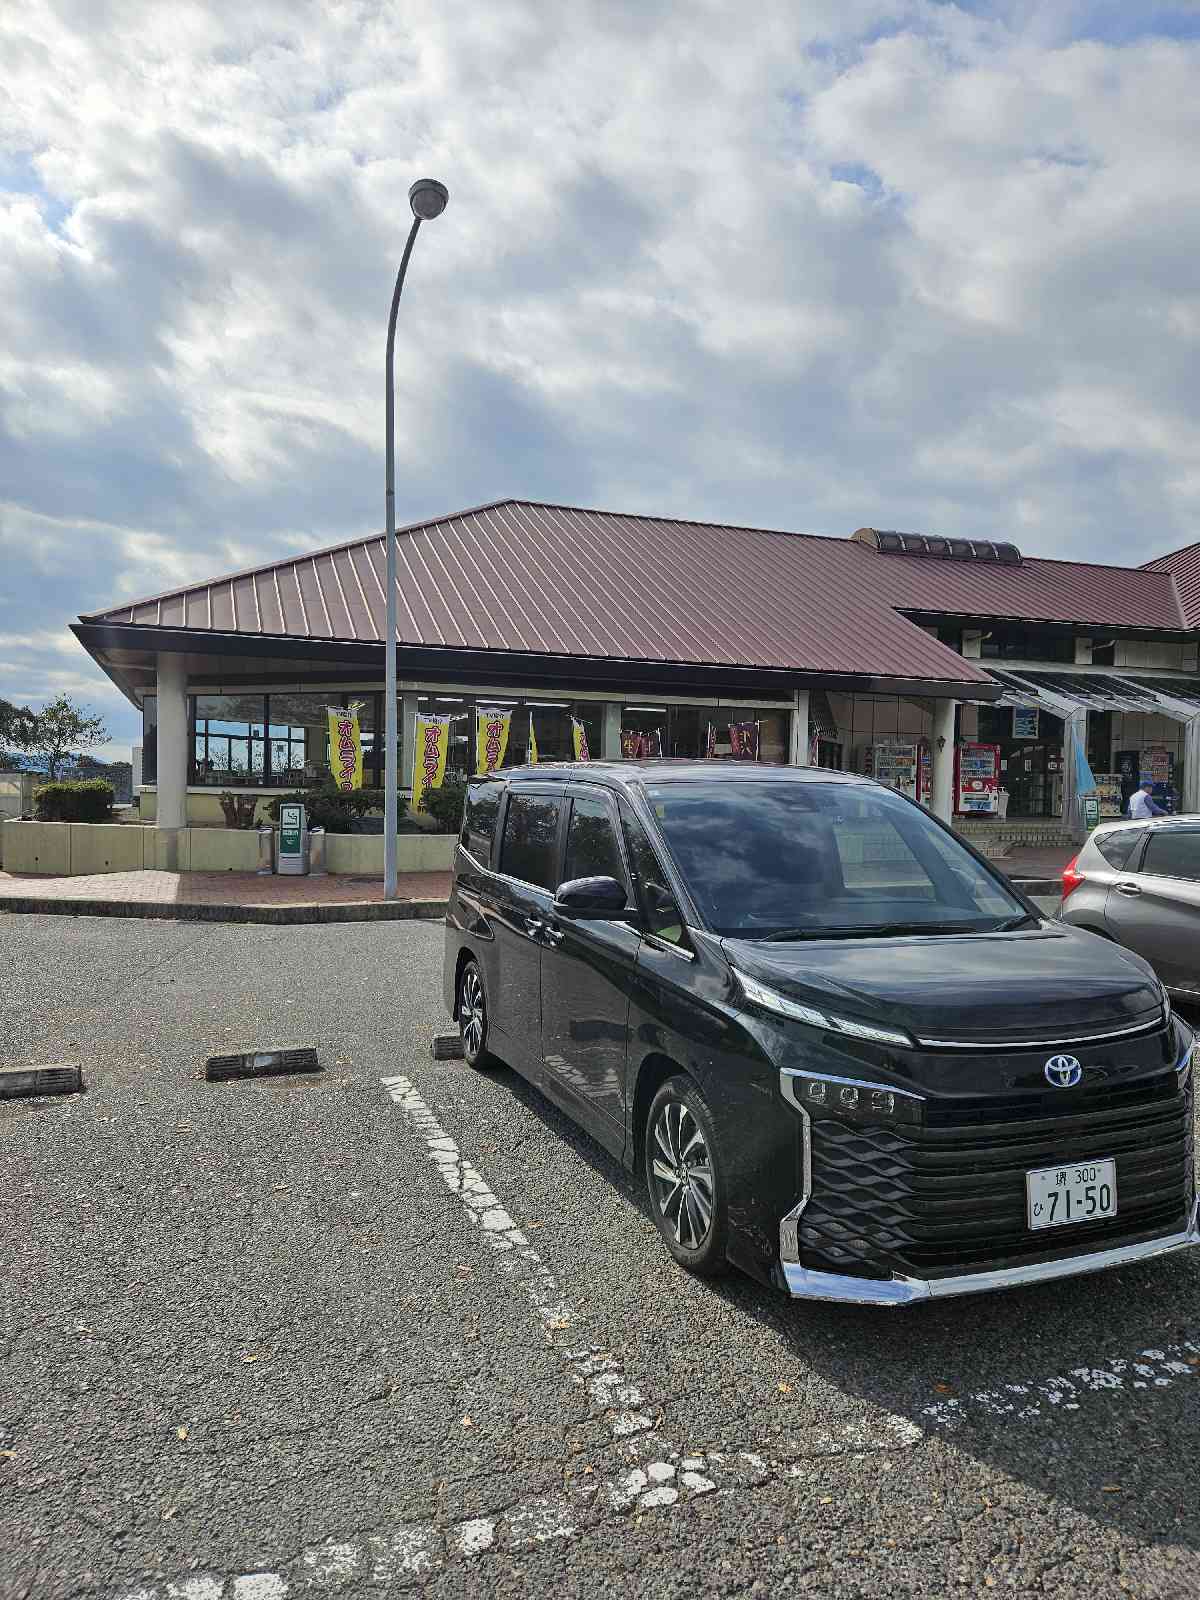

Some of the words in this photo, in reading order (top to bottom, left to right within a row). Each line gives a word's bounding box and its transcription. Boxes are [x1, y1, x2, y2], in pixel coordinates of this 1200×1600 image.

[1056, 1171, 1067, 1186] 堺
[1075, 1167, 1096, 1184] 300
[1033, 1202, 1044, 1217] ひ
[1047, 1183, 1111, 1222] 71-50
